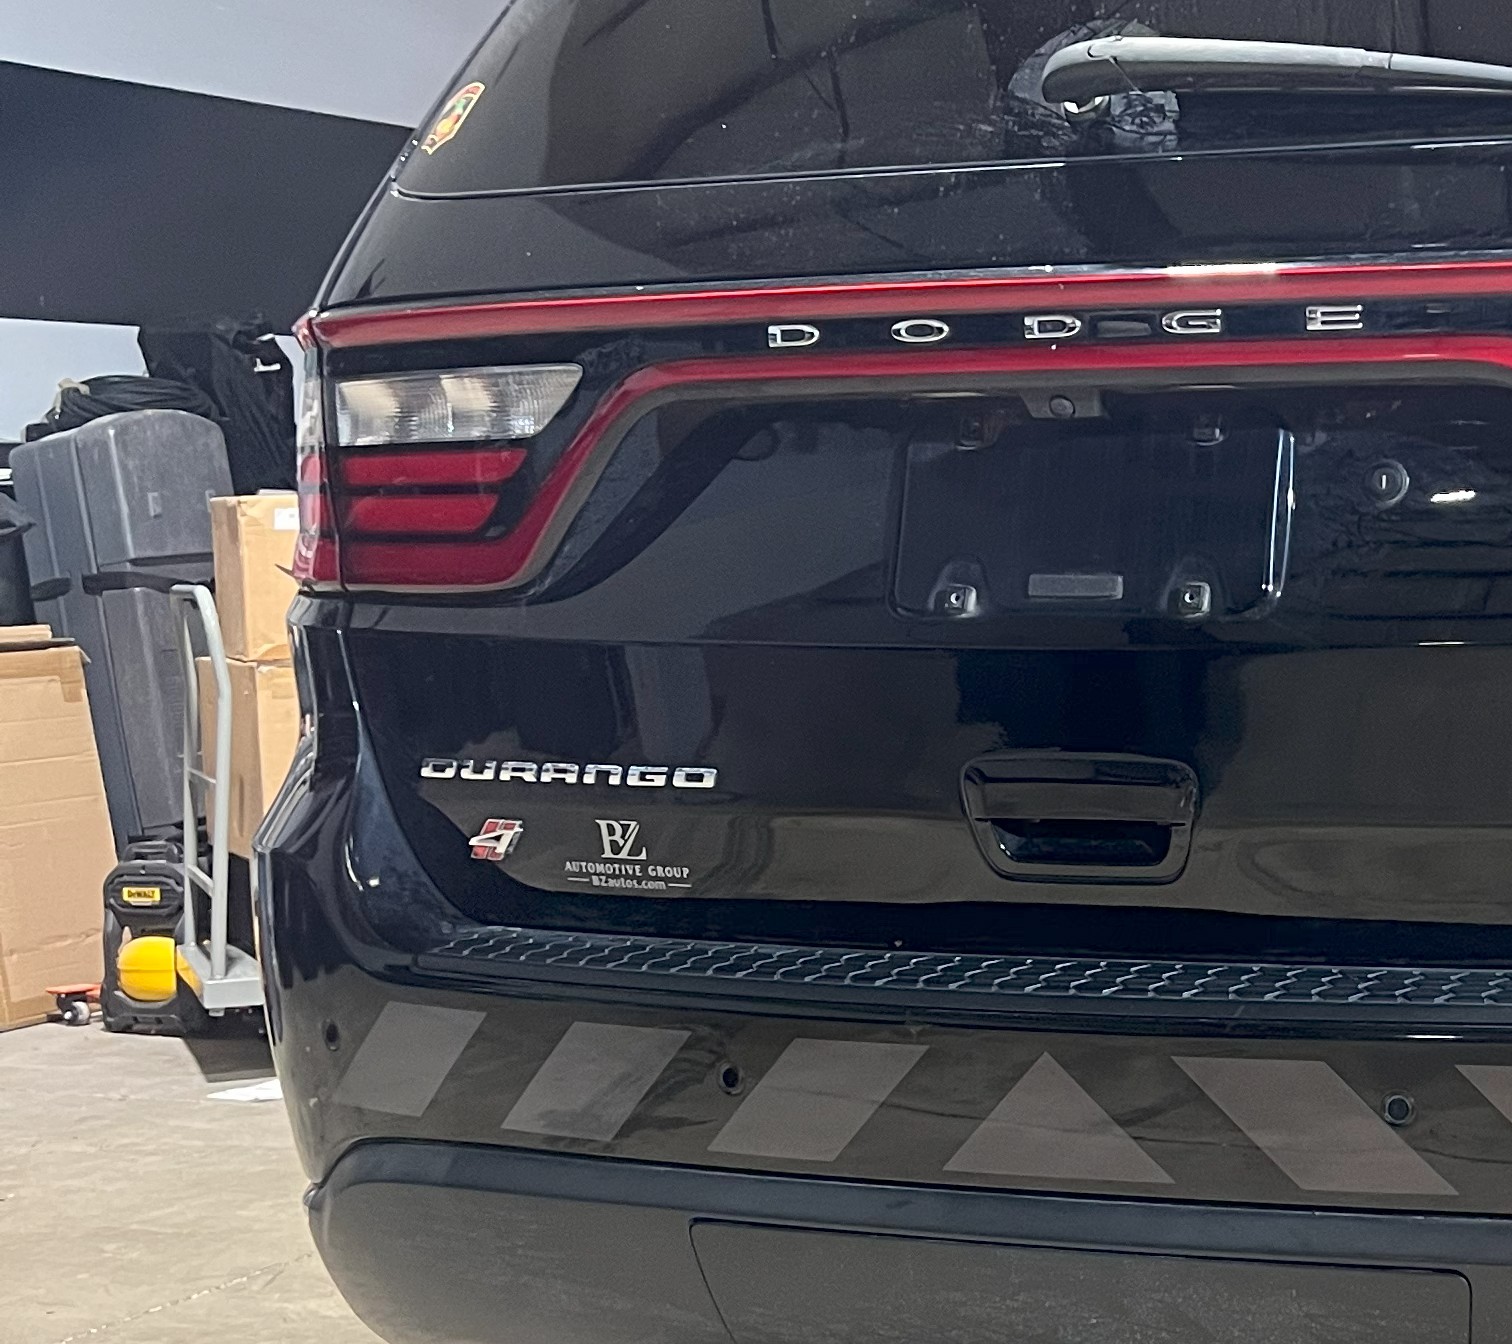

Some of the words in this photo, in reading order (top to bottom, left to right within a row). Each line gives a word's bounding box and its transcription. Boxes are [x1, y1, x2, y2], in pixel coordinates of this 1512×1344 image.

[767, 303, 1364, 349] DODGE
[420, 757, 718, 789] DURANGO
[594, 819, 647, 860] BZ
[564, 861, 643, 877] AUTOMOTIVE
[647, 865, 690, 879] GROUP
